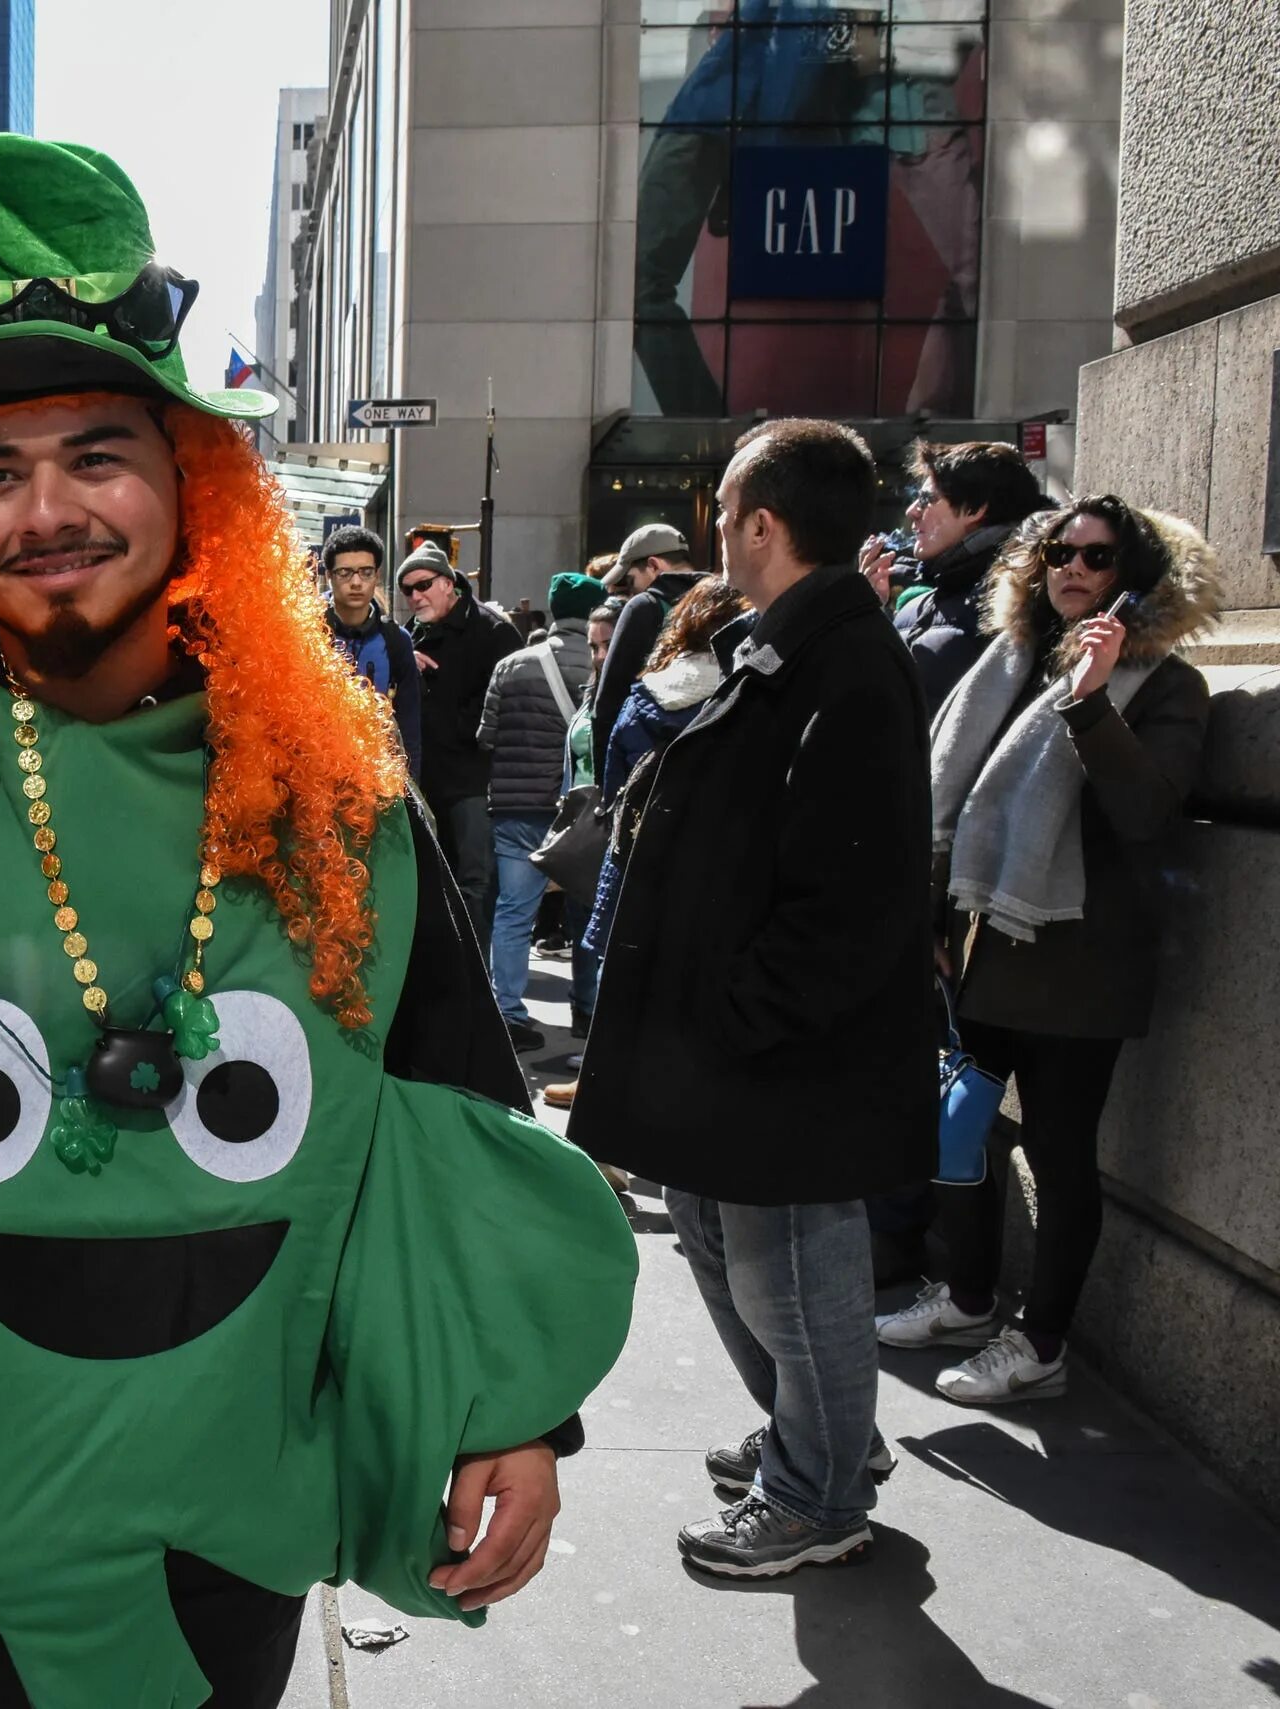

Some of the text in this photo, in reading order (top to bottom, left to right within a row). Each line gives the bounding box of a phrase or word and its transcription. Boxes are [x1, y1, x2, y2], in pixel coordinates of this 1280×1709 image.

[764, 187, 856, 255] GAP
[363, 406, 425, 420] ONE WAY
